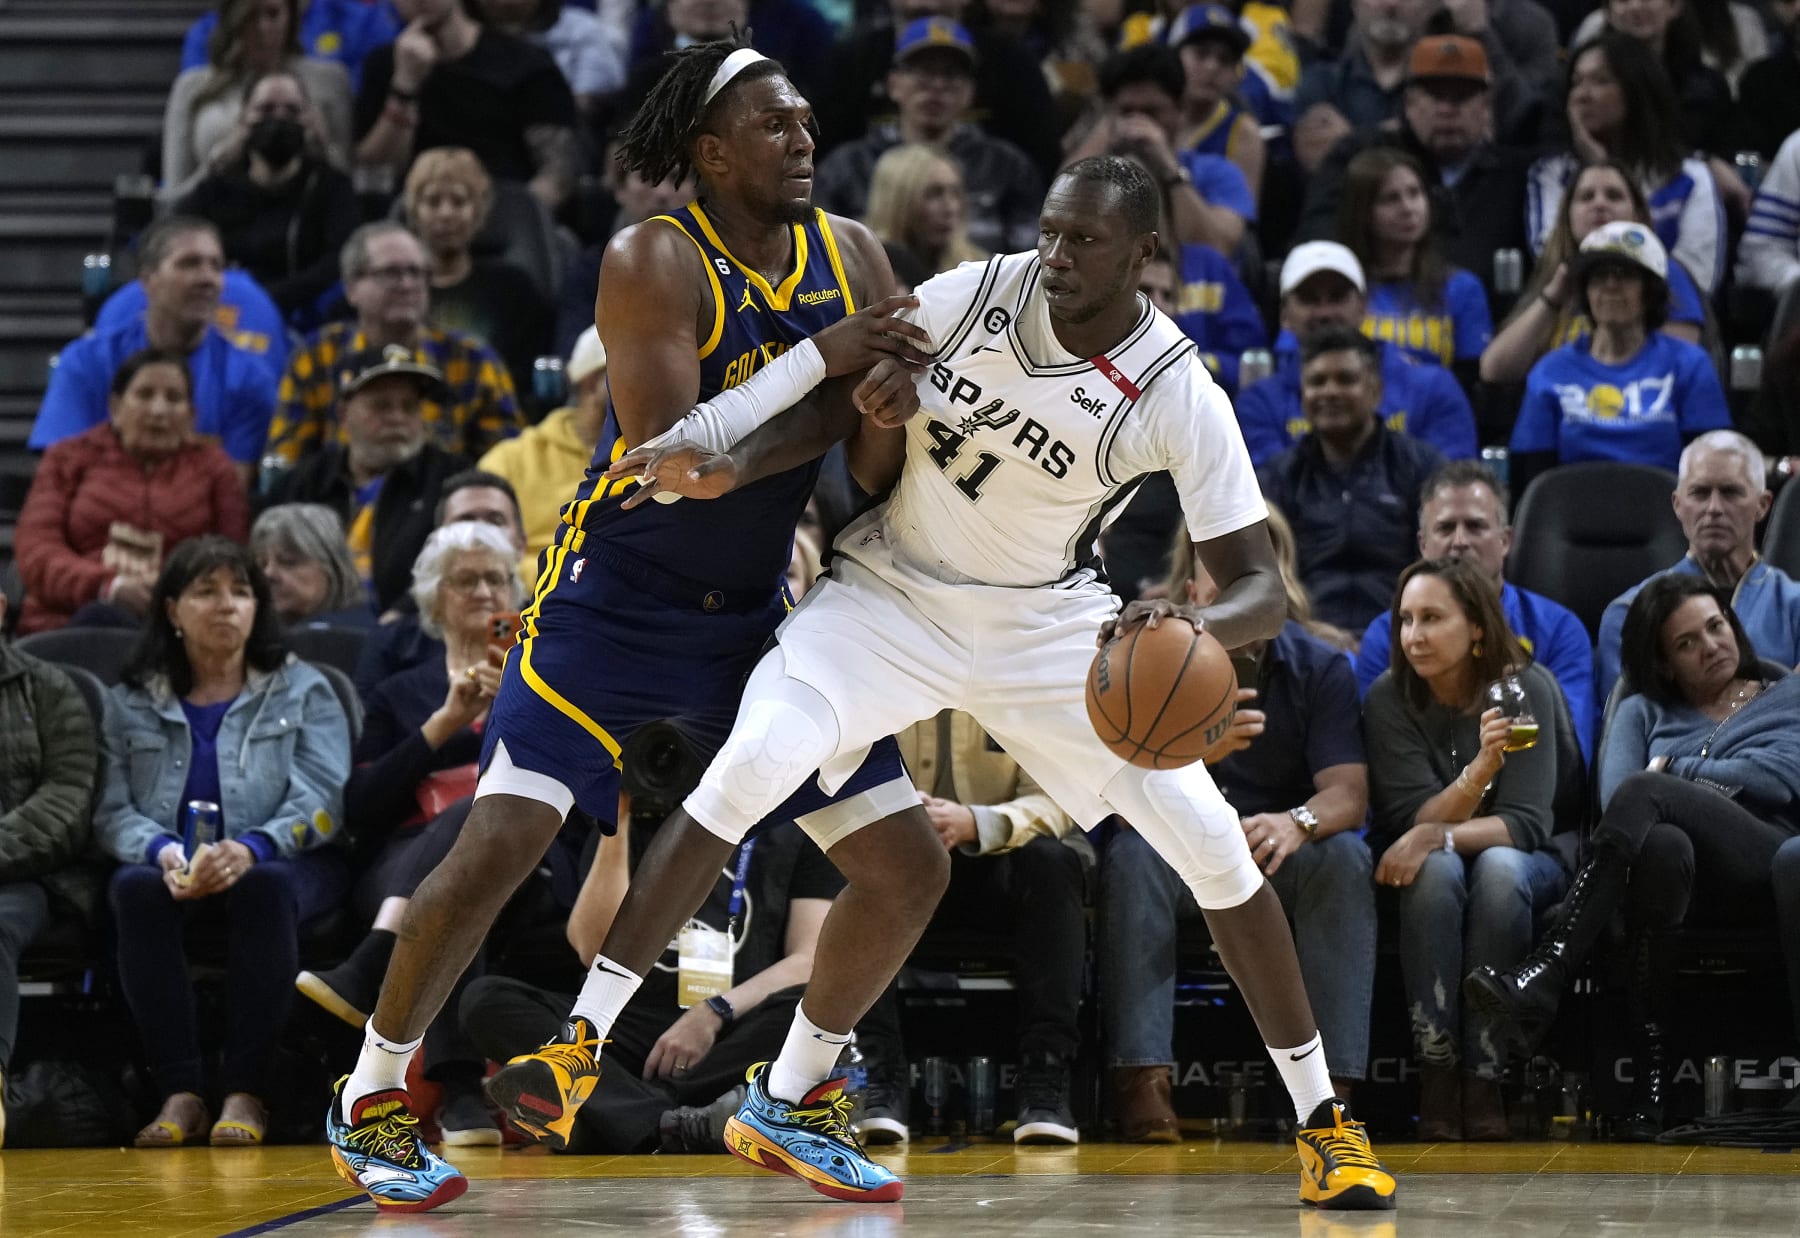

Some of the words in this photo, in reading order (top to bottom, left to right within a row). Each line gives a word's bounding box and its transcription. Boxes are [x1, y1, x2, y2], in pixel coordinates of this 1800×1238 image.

[714, 257, 731, 275] 6
[797, 288, 841, 305] Rakuten
[987, 310, 1006, 332] 6
[1070, 386, 1108, 420] Self.
[930, 362, 1076, 480] SPURS
[924, 416, 1005, 506] 41
[1168, 1060, 1267, 1087] HASE
